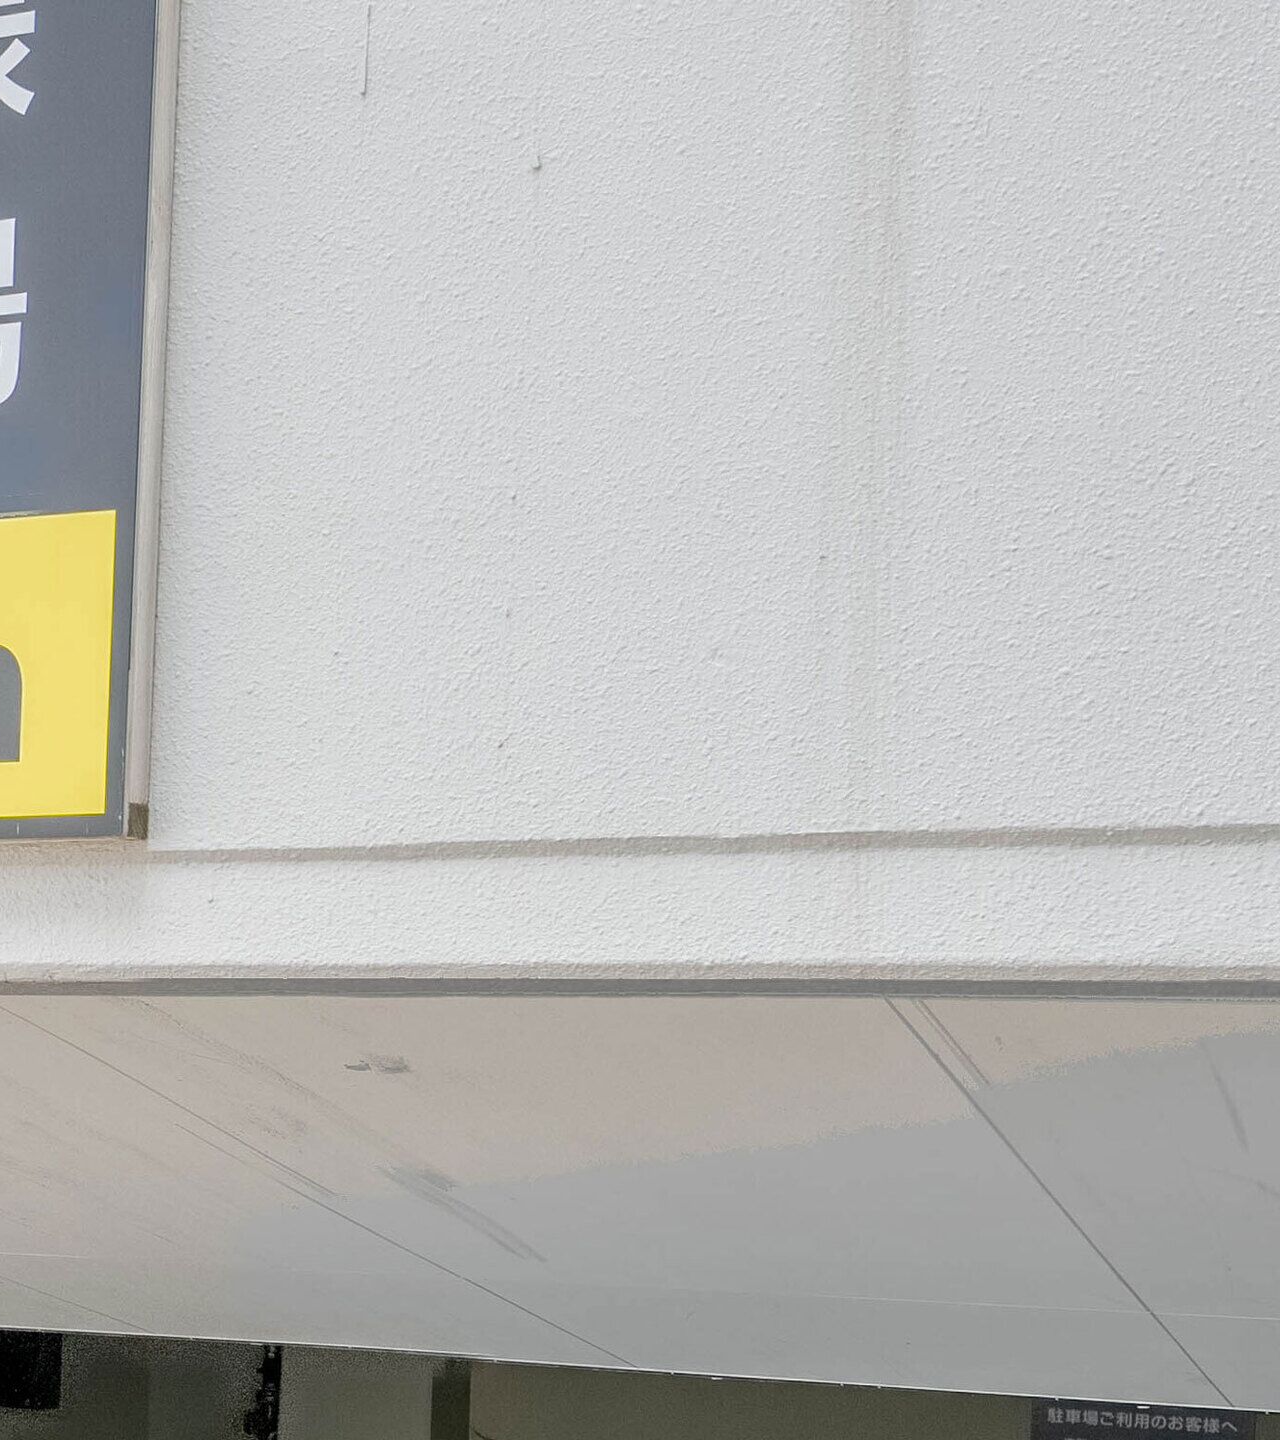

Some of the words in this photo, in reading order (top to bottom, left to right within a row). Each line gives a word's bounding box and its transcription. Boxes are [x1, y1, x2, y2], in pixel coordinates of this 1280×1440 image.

[1047, 1408, 1238, 1434] 駐車場ご利用のお客様へ
